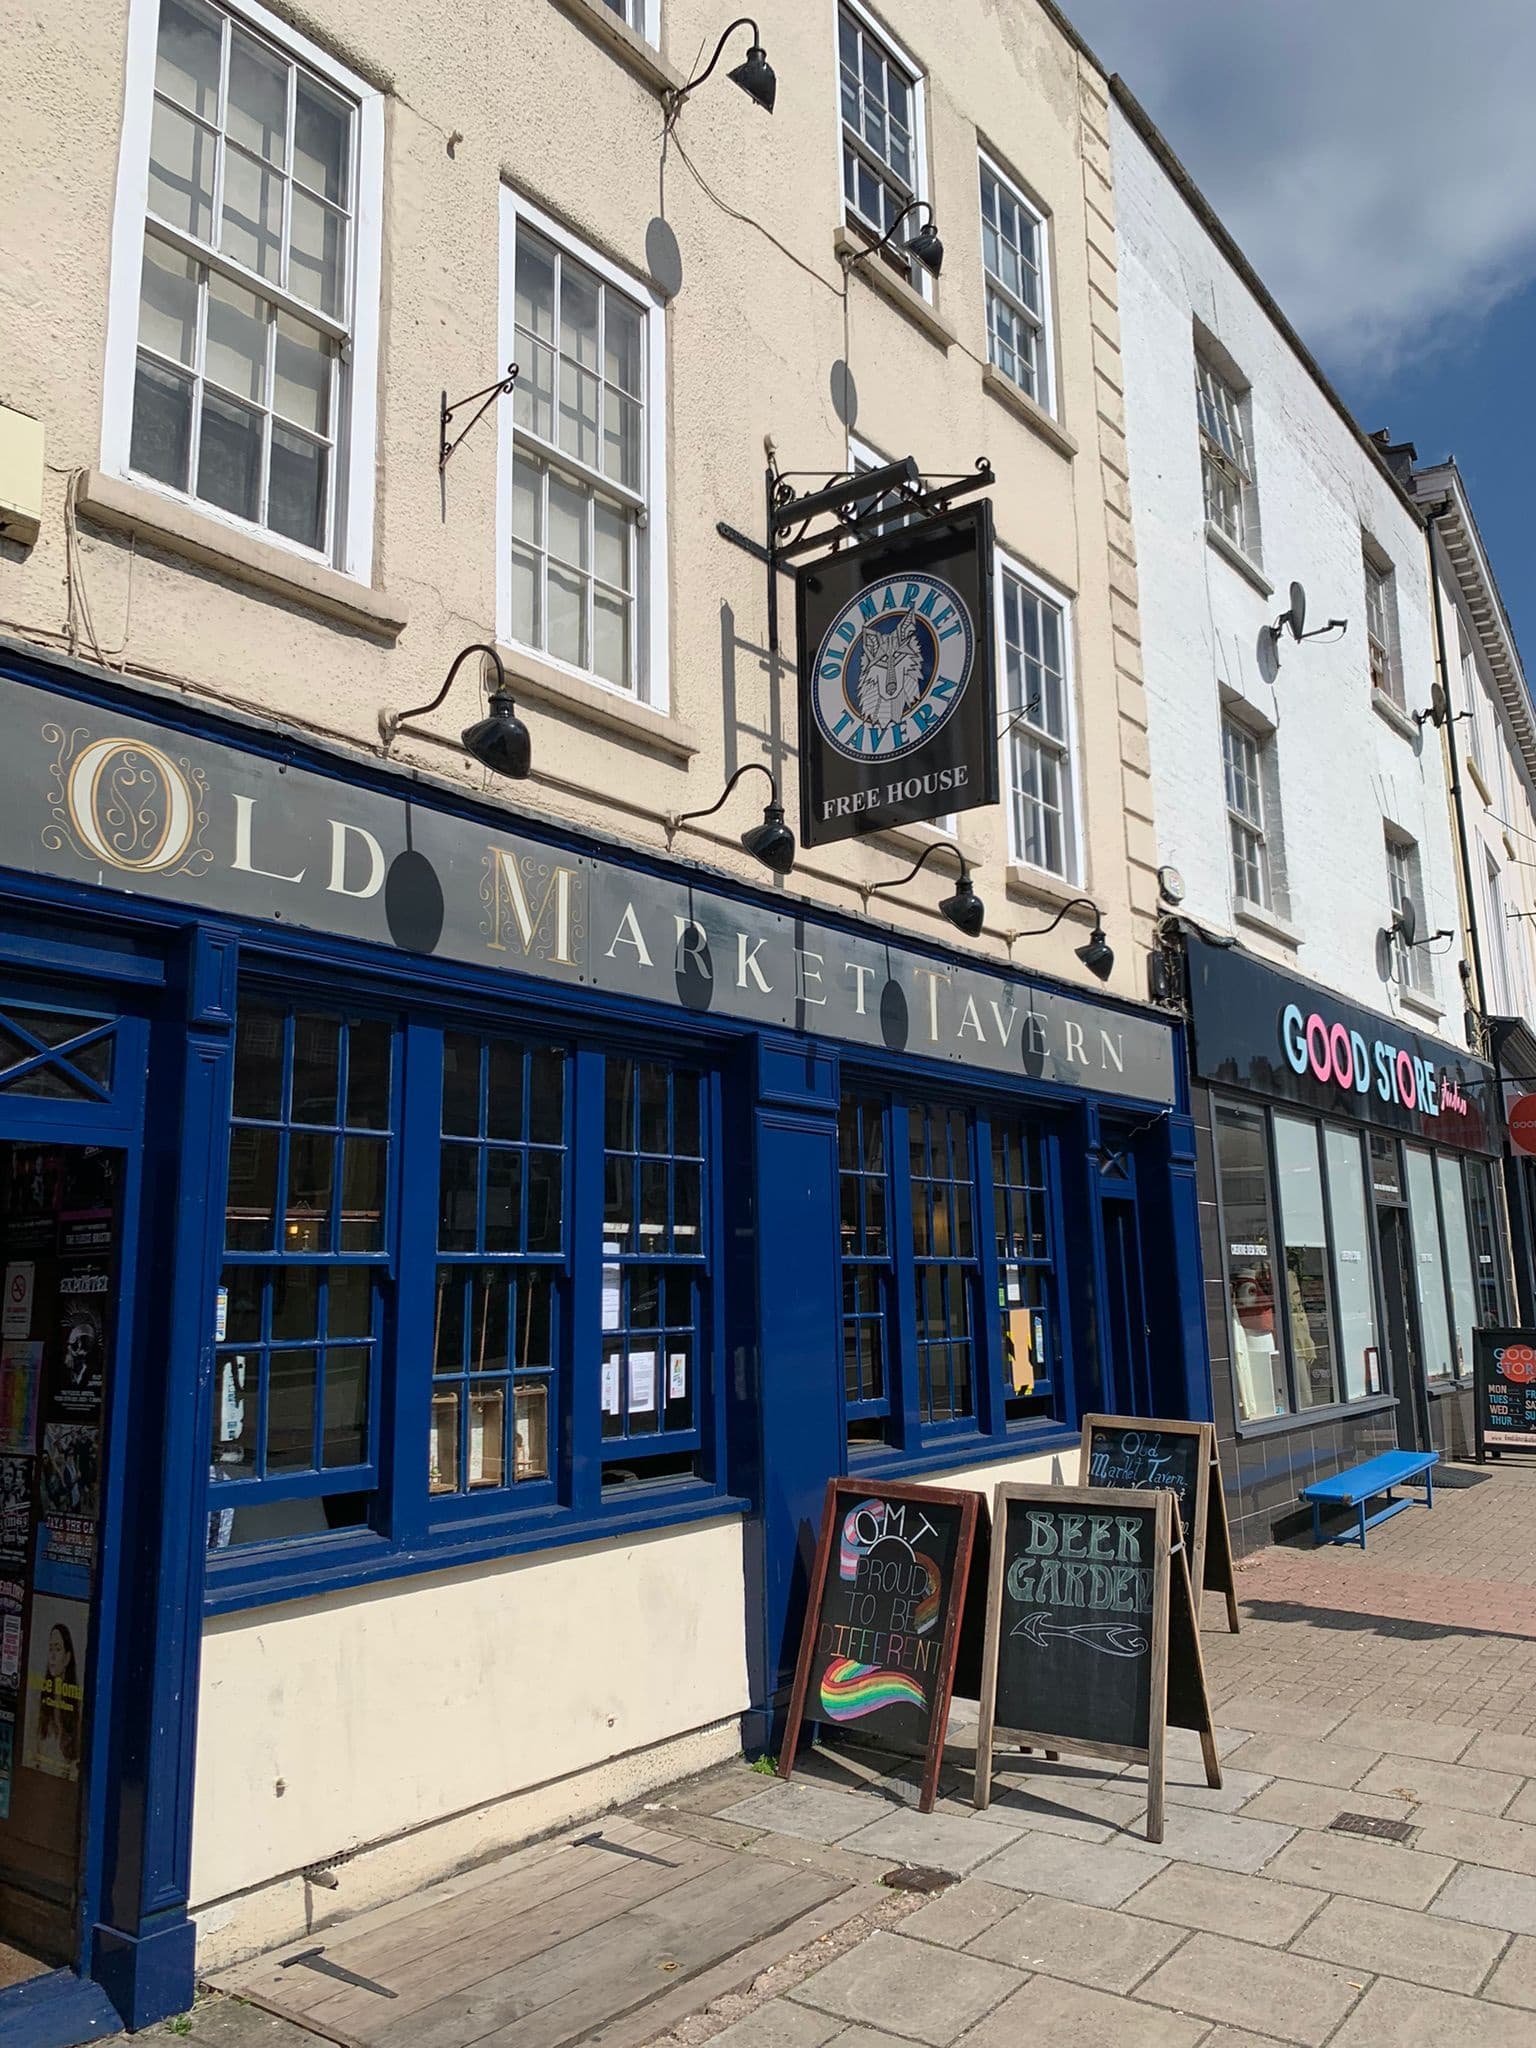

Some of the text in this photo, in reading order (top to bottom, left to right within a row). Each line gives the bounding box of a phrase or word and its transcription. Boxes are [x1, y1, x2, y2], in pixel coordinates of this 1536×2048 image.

[820, 582, 962, 680] OLD MARKET
[831, 676, 959, 752] TAVERN
[822, 764, 969, 821] FREE HOUSE
[66, 736, 1124, 1073] OLD MARKET TAVERN
[1282, 1003, 1370, 1094] GOOD
[1374, 1039, 1440, 1117] STORE
[1512, 1120, 1536, 1129] GOO
[1493, 1347, 1536, 1361] GOO
[1496, 1361, 1536, 1376] STOR
[1488, 1384, 1507, 1394] MON
[1489, 1394, 1509, 1404] TUES
[1525, 1389, 1536, 1400] FR
[1489, 1404, 1509, 1415] WED
[1490, 1415, 1513, 1426] THUR
[1524, 1410, 1536, 1421] SU
[1121, 1431, 1162, 1458] Old
[1091, 1452, 1143, 1481] Market
[1024, 1510, 1144, 1563] BEER
[853, 1557, 930, 1597] PROUD
[1007, 1556, 1154, 1614] GARDEN
[844, 1590, 921, 1635] TO BE
[817, 1622, 944, 1675] DIFFERENT
